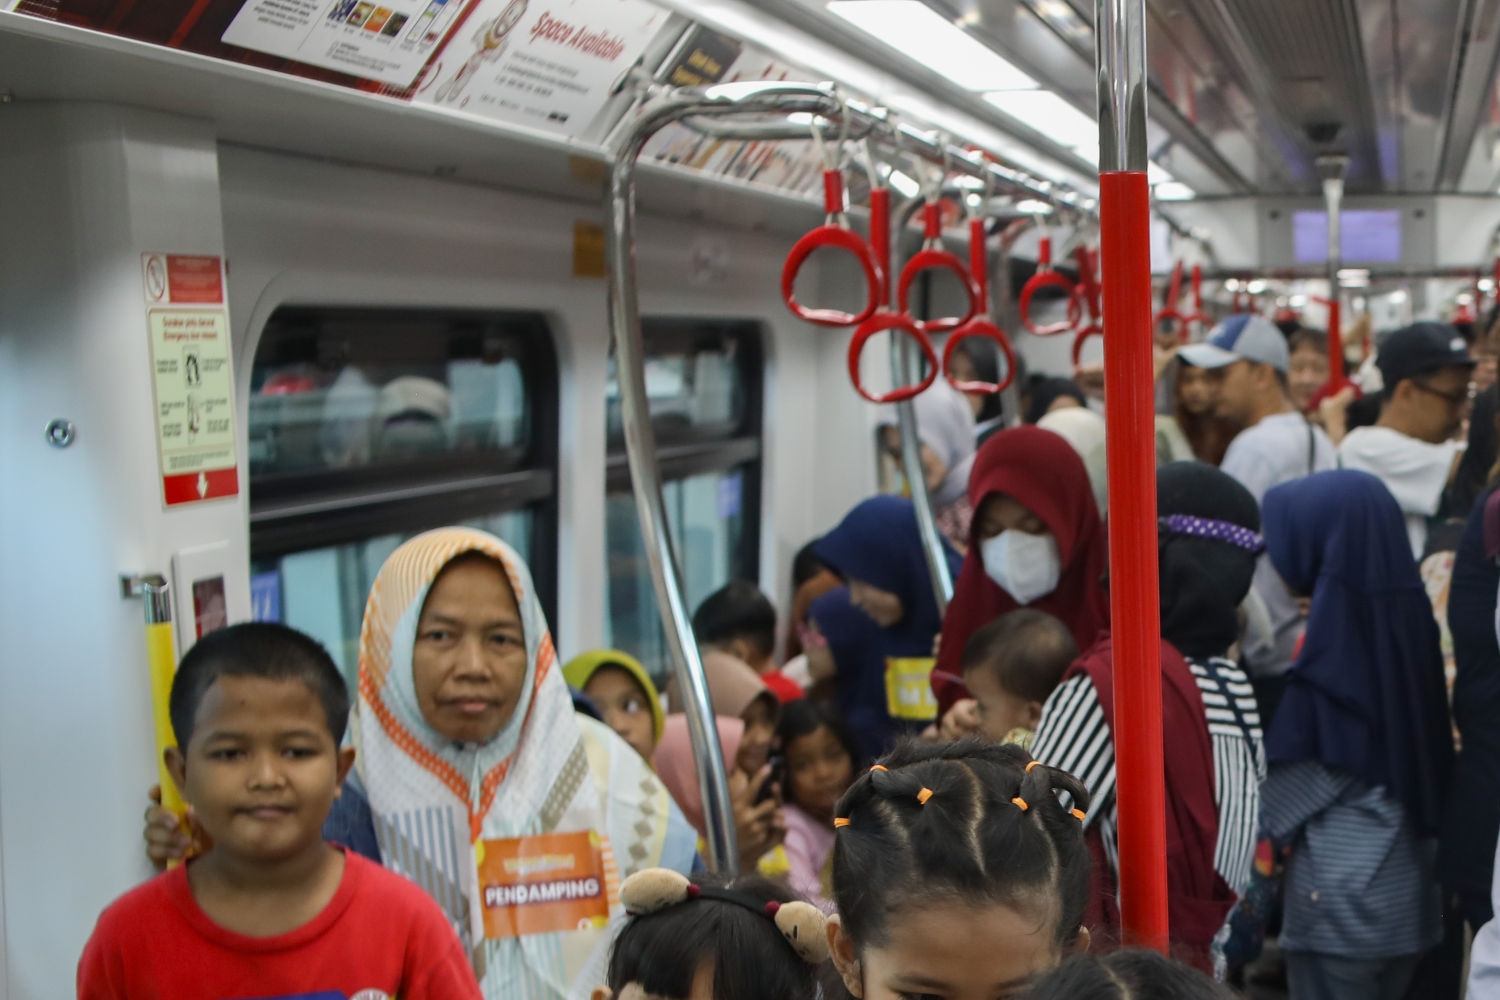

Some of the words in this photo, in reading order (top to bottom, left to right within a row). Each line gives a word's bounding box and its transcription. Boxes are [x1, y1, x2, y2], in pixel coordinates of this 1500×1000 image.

[530, 10, 575, 45] Space
[569, 25, 626, 61] Available
[485, 878, 599, 907] PENDAMPING
